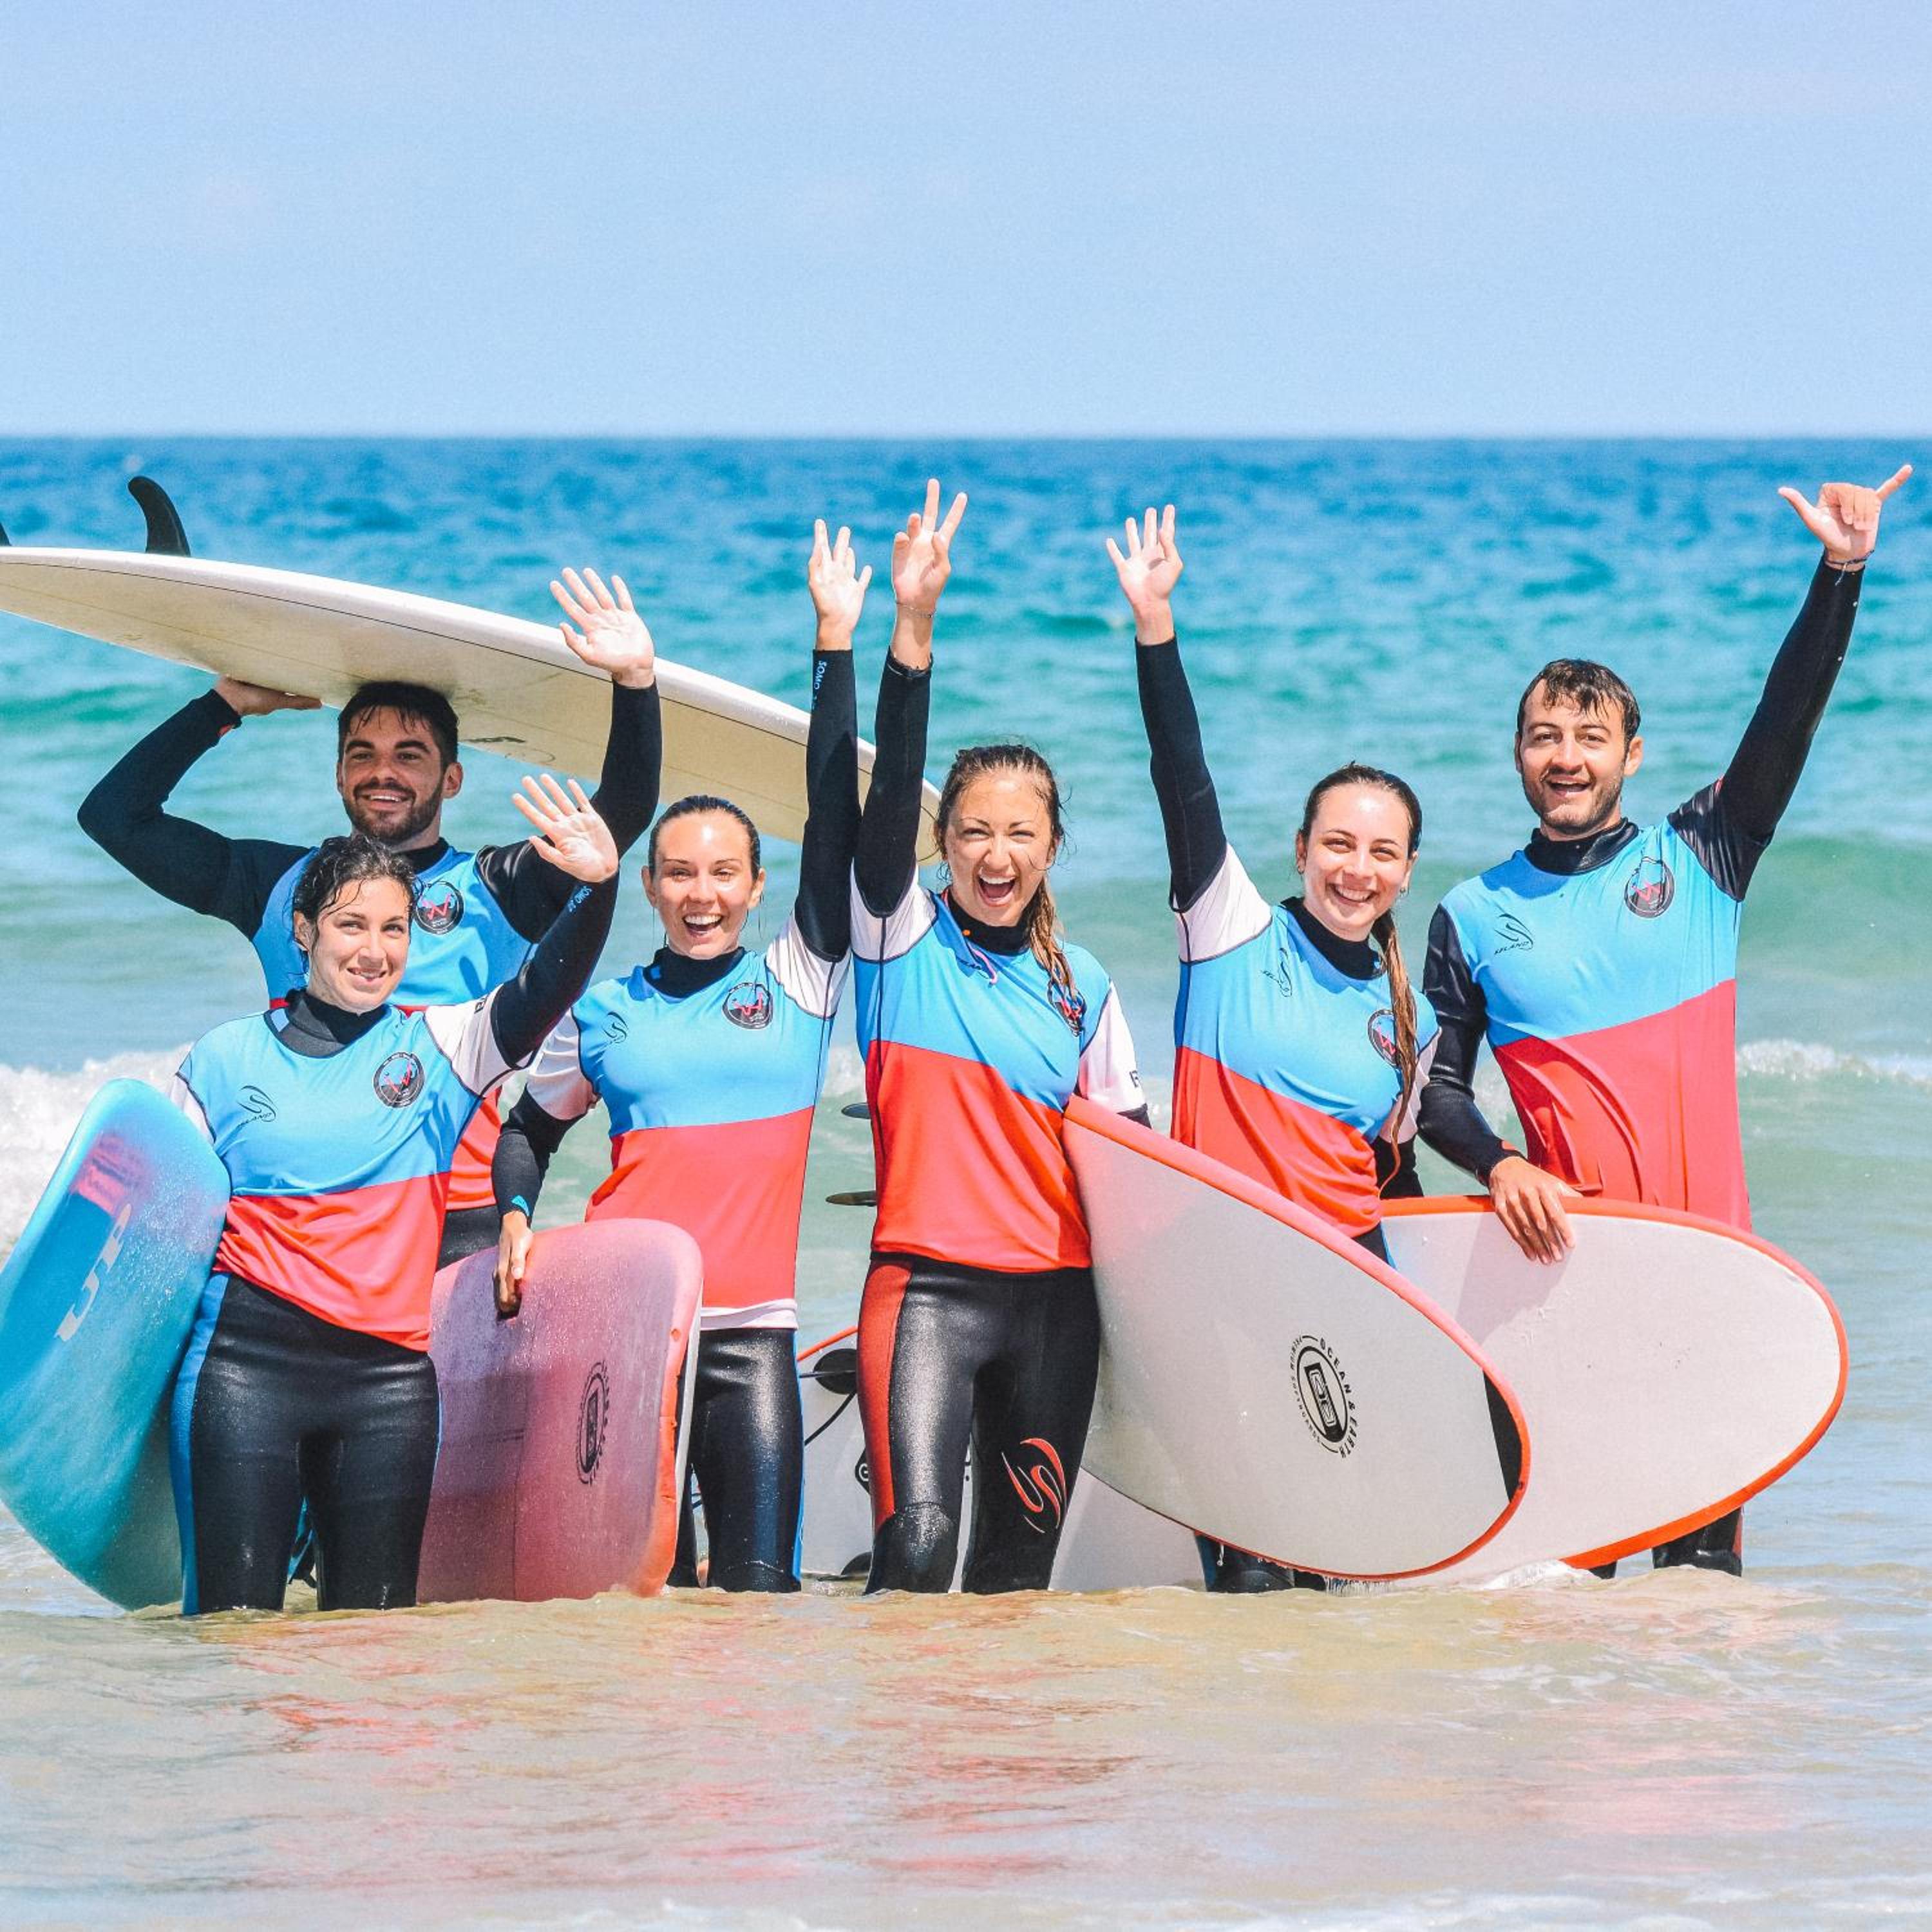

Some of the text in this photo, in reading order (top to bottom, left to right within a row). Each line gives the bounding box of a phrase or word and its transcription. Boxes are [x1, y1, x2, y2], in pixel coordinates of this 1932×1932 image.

[813, 660, 828, 690] SOMO
[1320, 1337, 1358, 1459] OCEAN & EARTH
